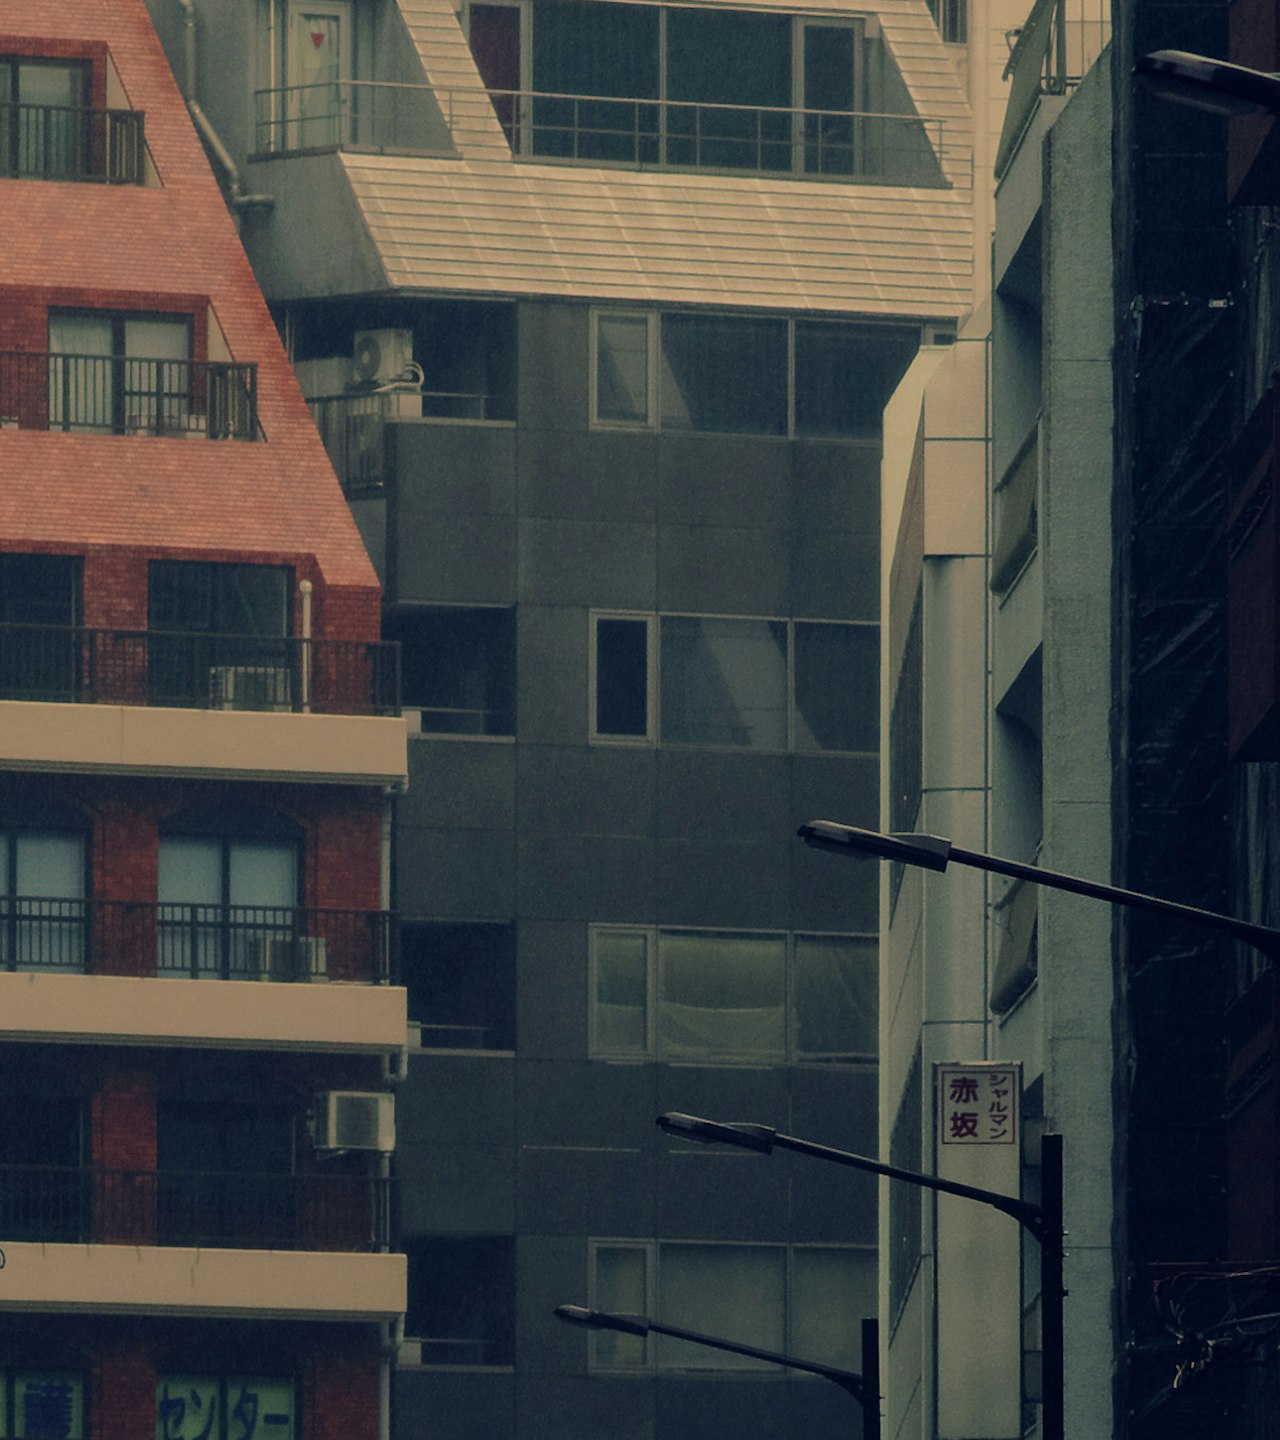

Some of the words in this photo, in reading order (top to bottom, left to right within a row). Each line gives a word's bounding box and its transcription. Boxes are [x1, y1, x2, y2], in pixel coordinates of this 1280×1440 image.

[949, 1076, 979, 1139] 赤坂
[989, 1074, 1009, 1140] シャルマン
